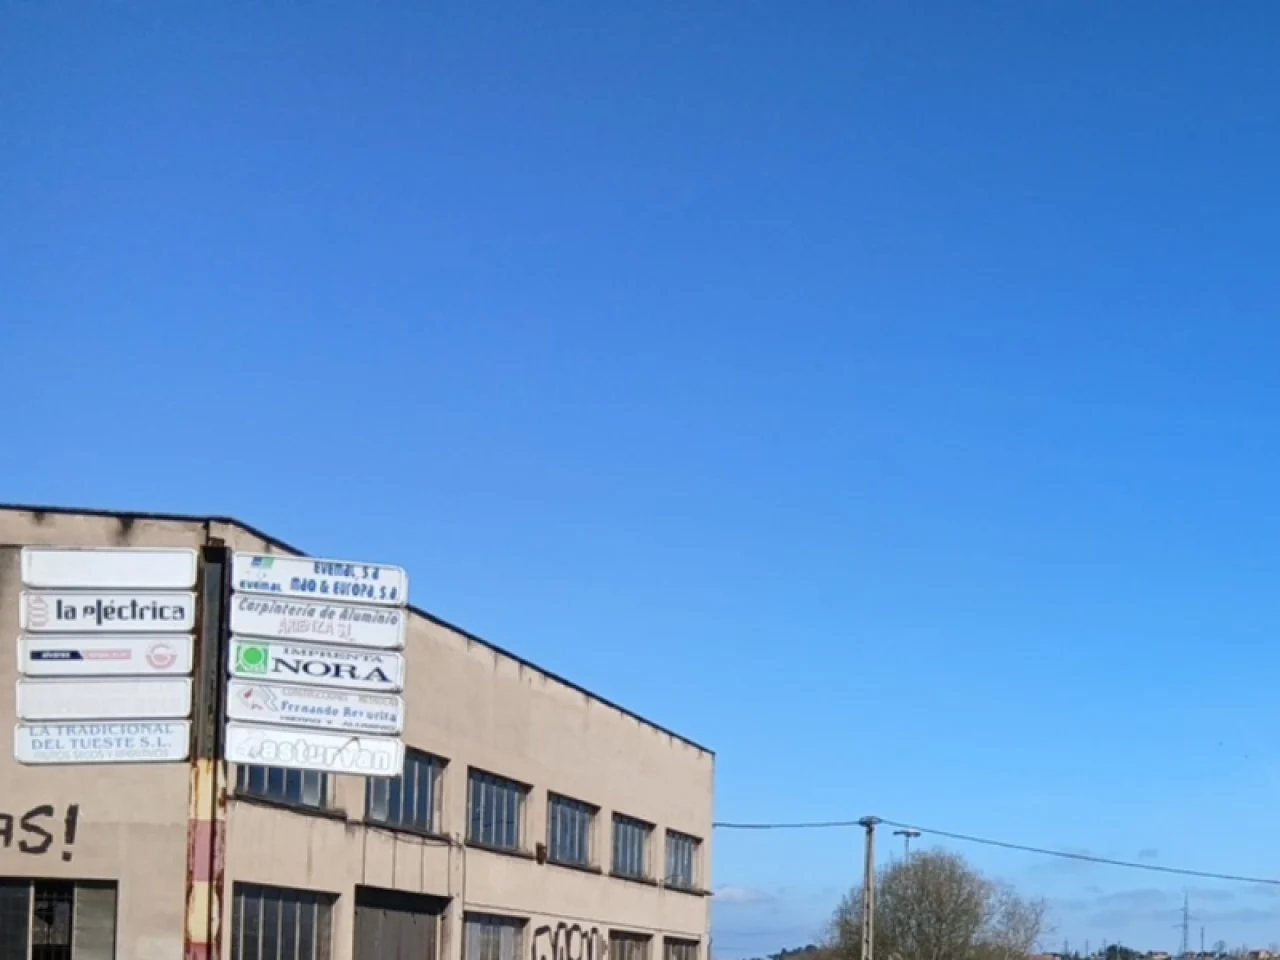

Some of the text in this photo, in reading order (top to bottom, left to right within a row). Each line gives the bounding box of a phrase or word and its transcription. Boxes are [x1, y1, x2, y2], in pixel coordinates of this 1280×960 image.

[56, 598, 77, 620] la
[319, 605, 335, 619] de
[338, 607, 398, 625] Aluminio
[272, 657, 392, 683] NORA
[281, 700, 339, 717] Fernando
[29, 723, 174, 737] LA TRADICIONAL
[32, 738, 65, 750] DEL
[71, 737, 135, 749] TUESTE
